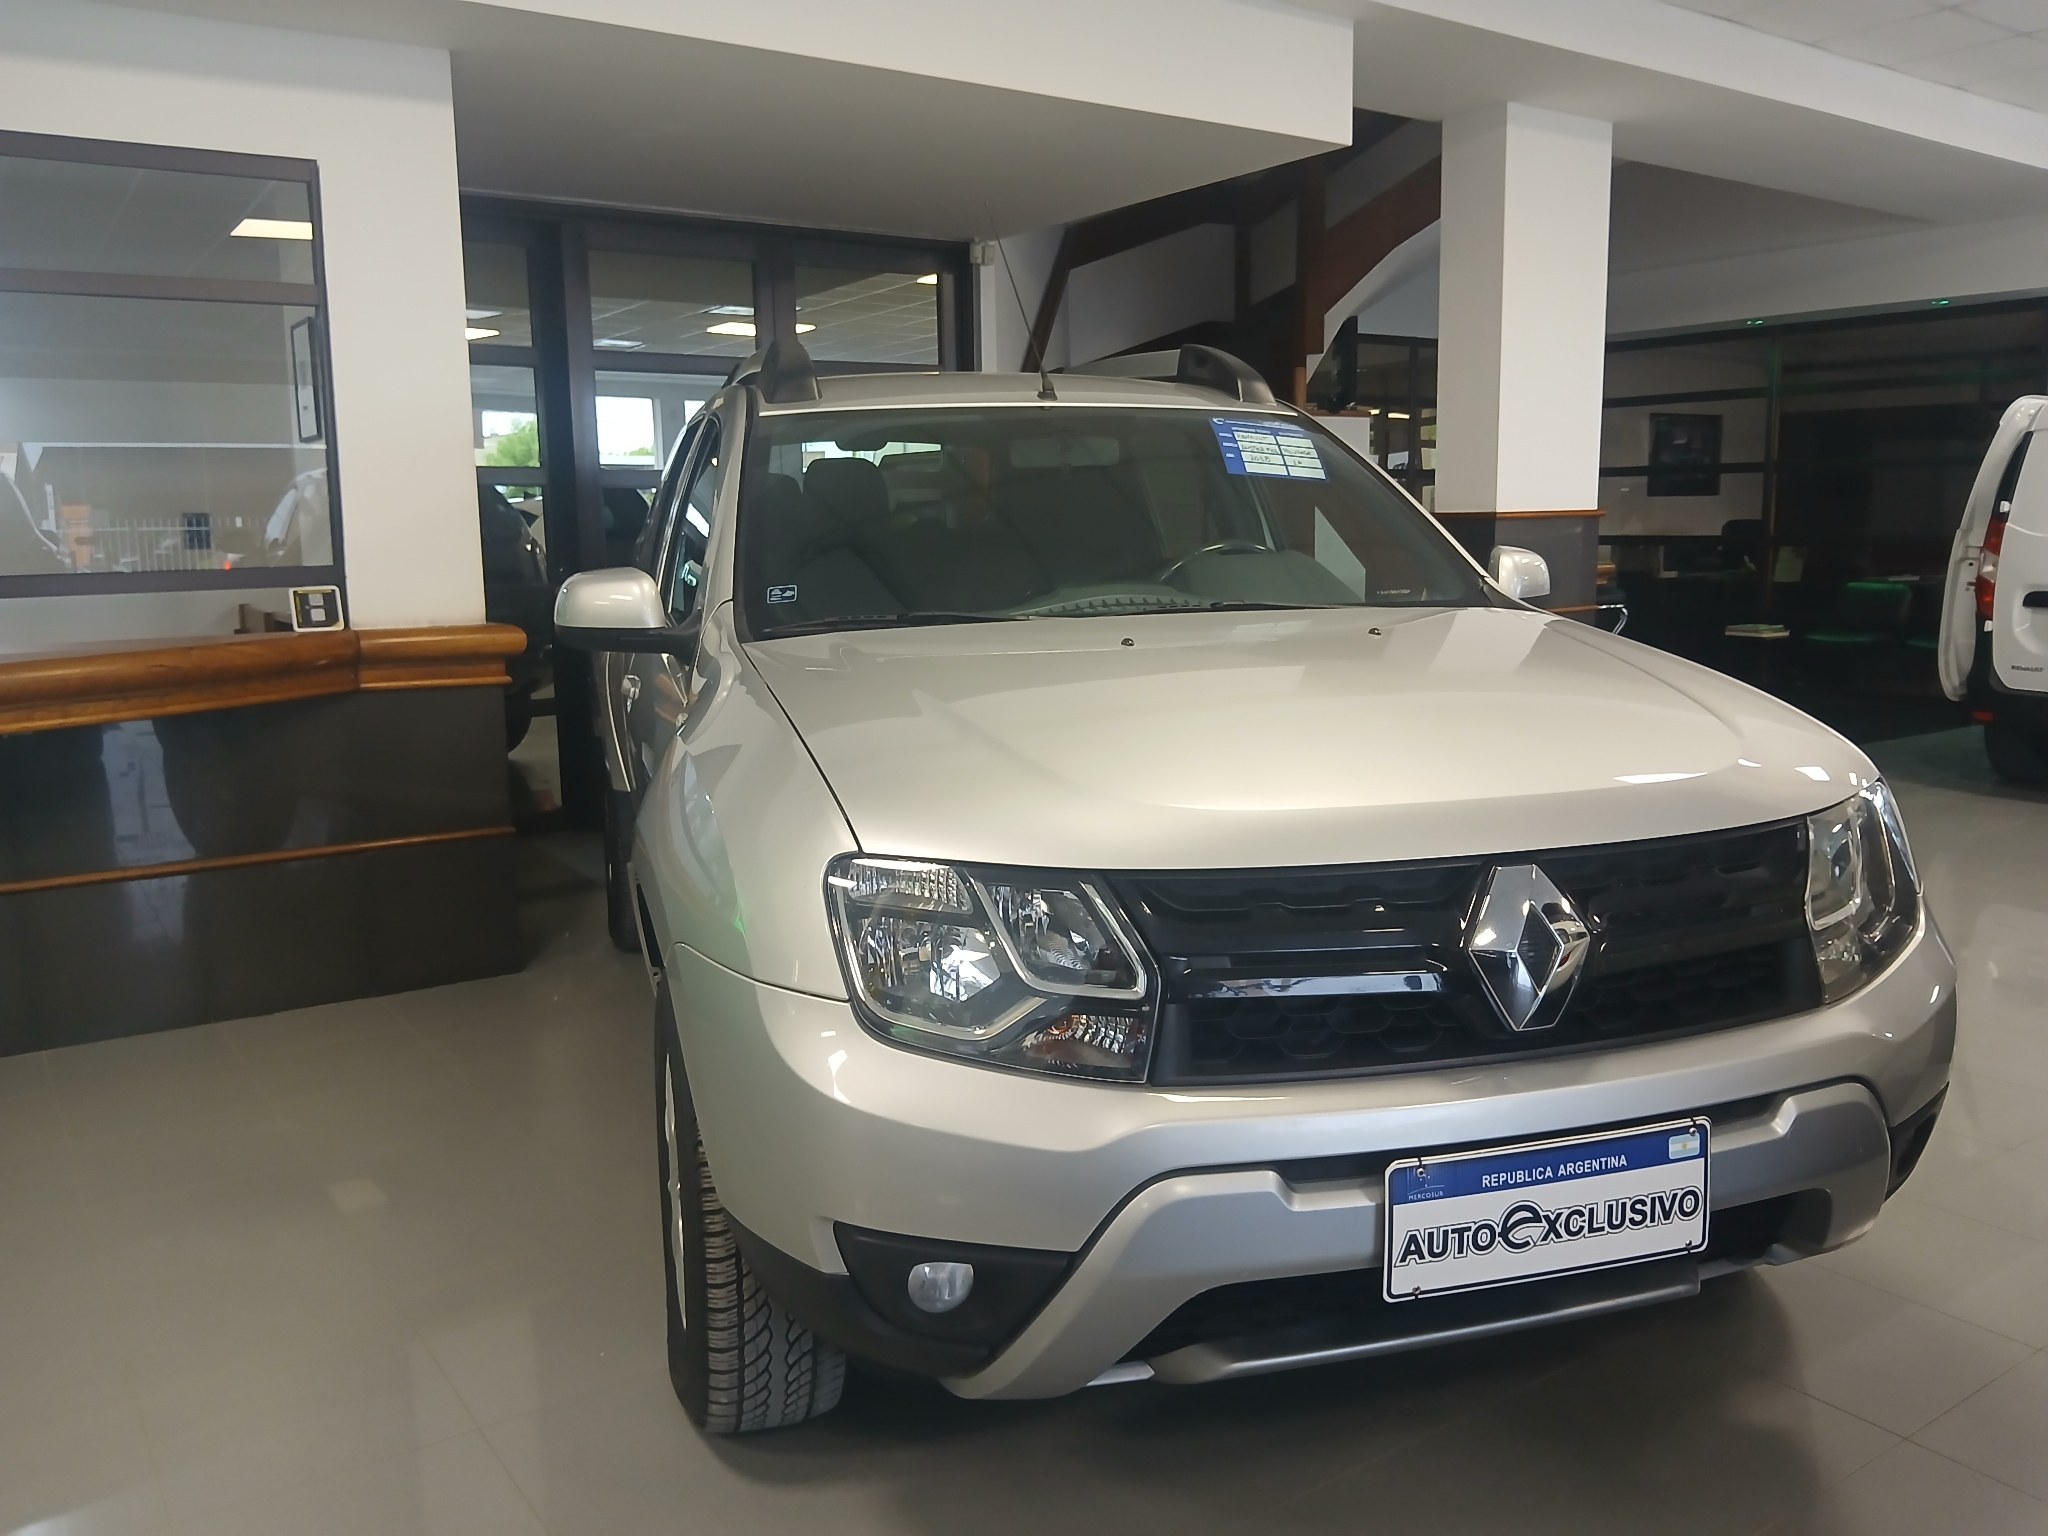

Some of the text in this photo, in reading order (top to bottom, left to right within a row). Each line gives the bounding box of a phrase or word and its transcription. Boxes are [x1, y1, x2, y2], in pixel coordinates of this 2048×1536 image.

[1482, 1154, 1628, 1188] REPUBLICA ARGENTINA
[1408, 1190, 1444, 1200] MERCOSUR
